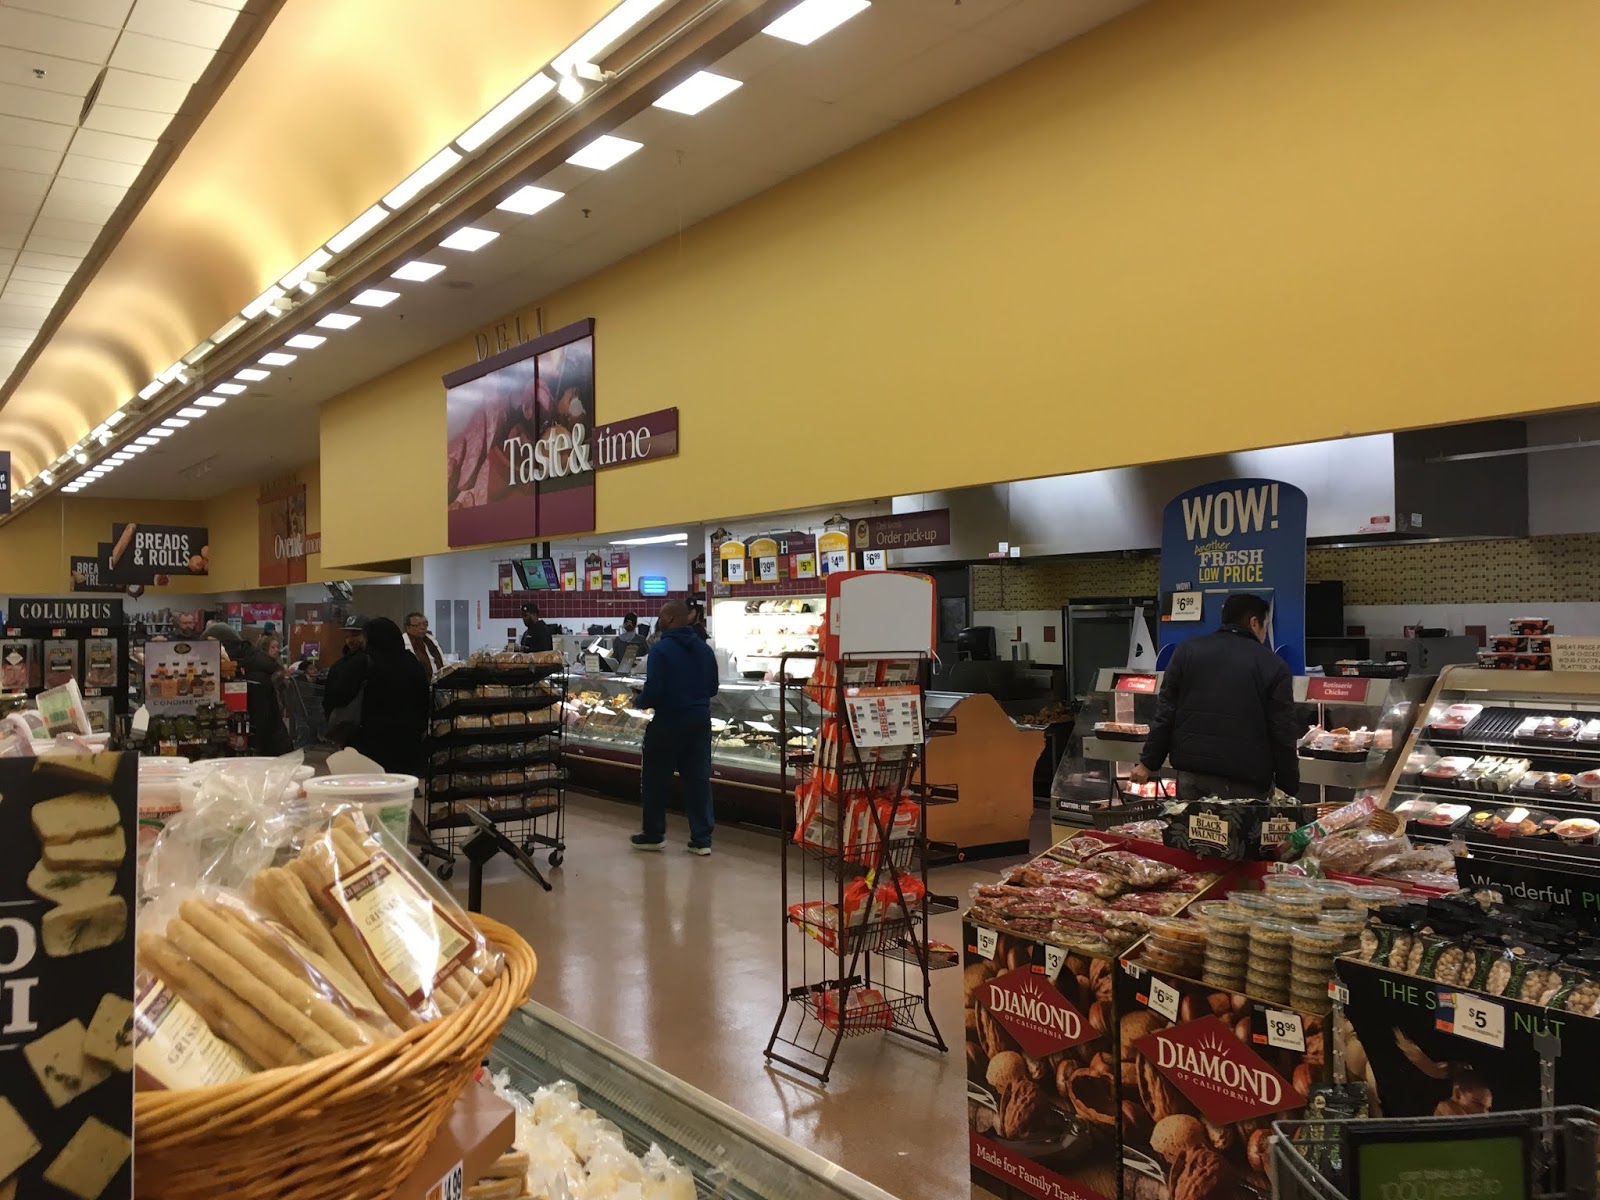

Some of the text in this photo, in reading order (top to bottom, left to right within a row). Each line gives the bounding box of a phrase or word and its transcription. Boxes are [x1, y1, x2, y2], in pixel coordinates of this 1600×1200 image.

[475, 307, 544, 362] DELI
[597, 426, 651, 466] time
[1181, 483, 1280, 541] WOW!
[135, 532, 190, 551] BREADS
[876, 526, 938, 547] Order pick-up
[133, 549, 191, 567] & ROLLS
[1194, 540, 1231, 556] Another
[1200, 549, 1264, 568] FRESH
[1199, 564, 1264, 584] LOW PRICE
[1176, 582, 1191, 592] WOW!
[20, 603, 111, 619] COLUMBUS
[1322, 681, 1353, 690] Rotisserie
[1323, 688, 1349, 697] Chicken
[1196, 817, 1222, 832] BLACK
[1268, 822, 1291, 833] BLACK
[1190, 826, 1227, 844] WALNUTS
[1470, 873, 1568, 906] Wnderful
[989, 984, 1082, 1040] DIAMOND
[1379, 978, 1420, 1007] THE
[1513, 1011, 1566, 1038] NUT
[1004, 1013, 1063, 1041] OF CALIFORNIA
[1156, 1036, 1283, 1106] DIAMOND
[1177, 1071, 1256, 1106] OF CALIFORNIA
[976, 1143, 1002, 1167] Made
[1003, 1156, 1018, 1176] for
[1018, 1164, 1052, 1196] Family
